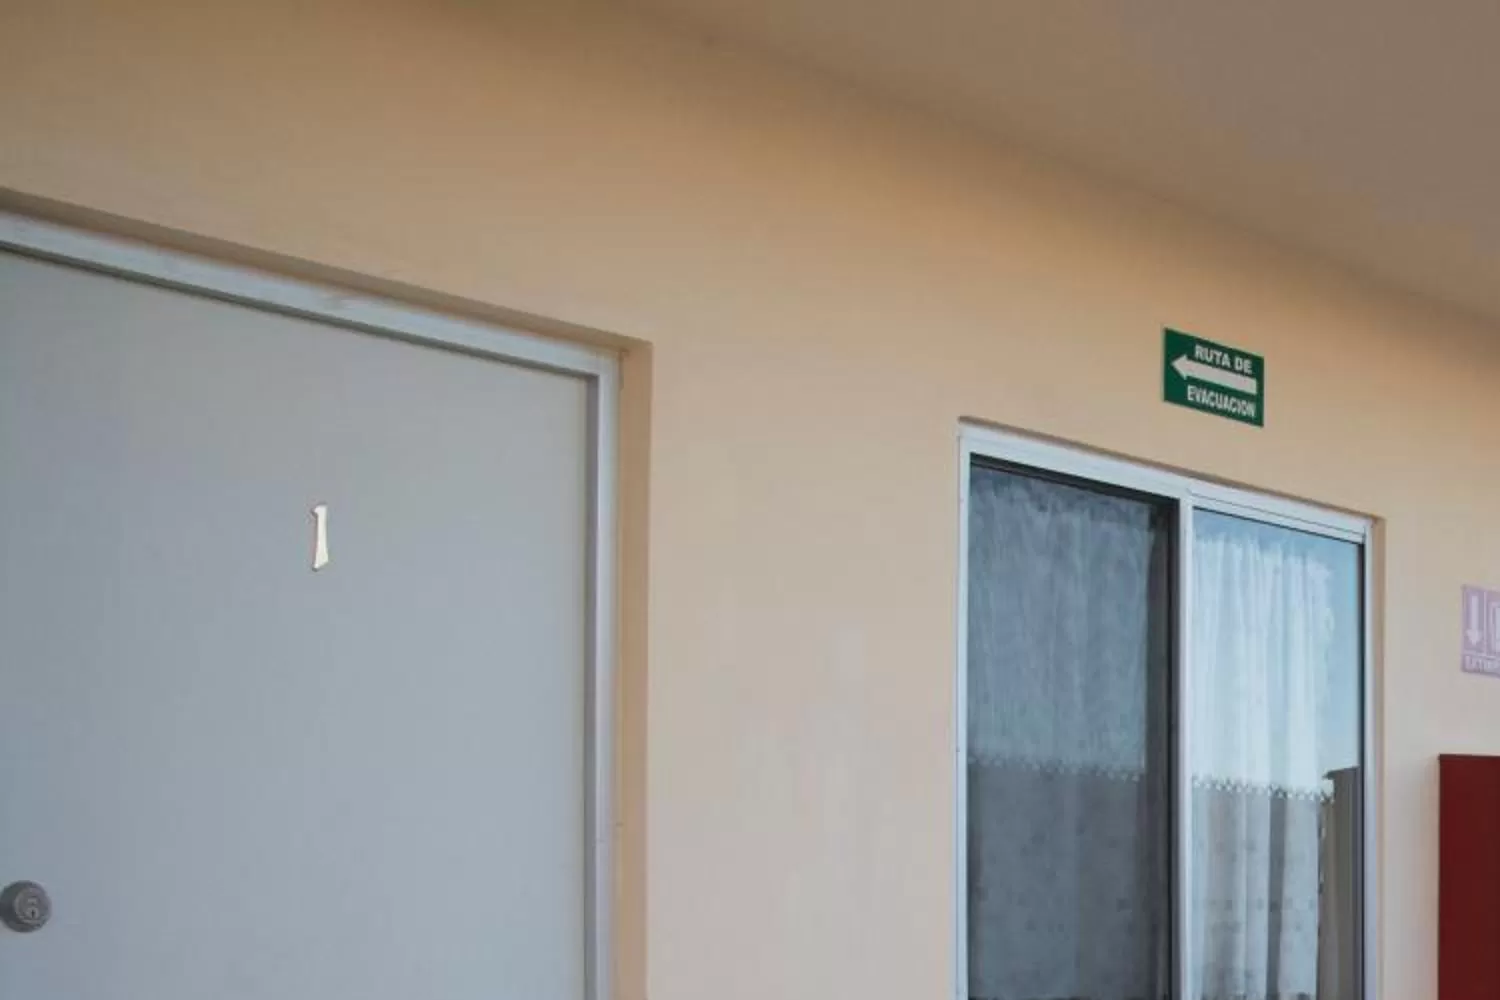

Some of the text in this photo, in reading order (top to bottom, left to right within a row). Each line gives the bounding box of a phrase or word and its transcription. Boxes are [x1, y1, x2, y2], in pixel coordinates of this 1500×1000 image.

[1194, 344, 1253, 375] RUTA DE
[313, 503, 329, 570] 1
